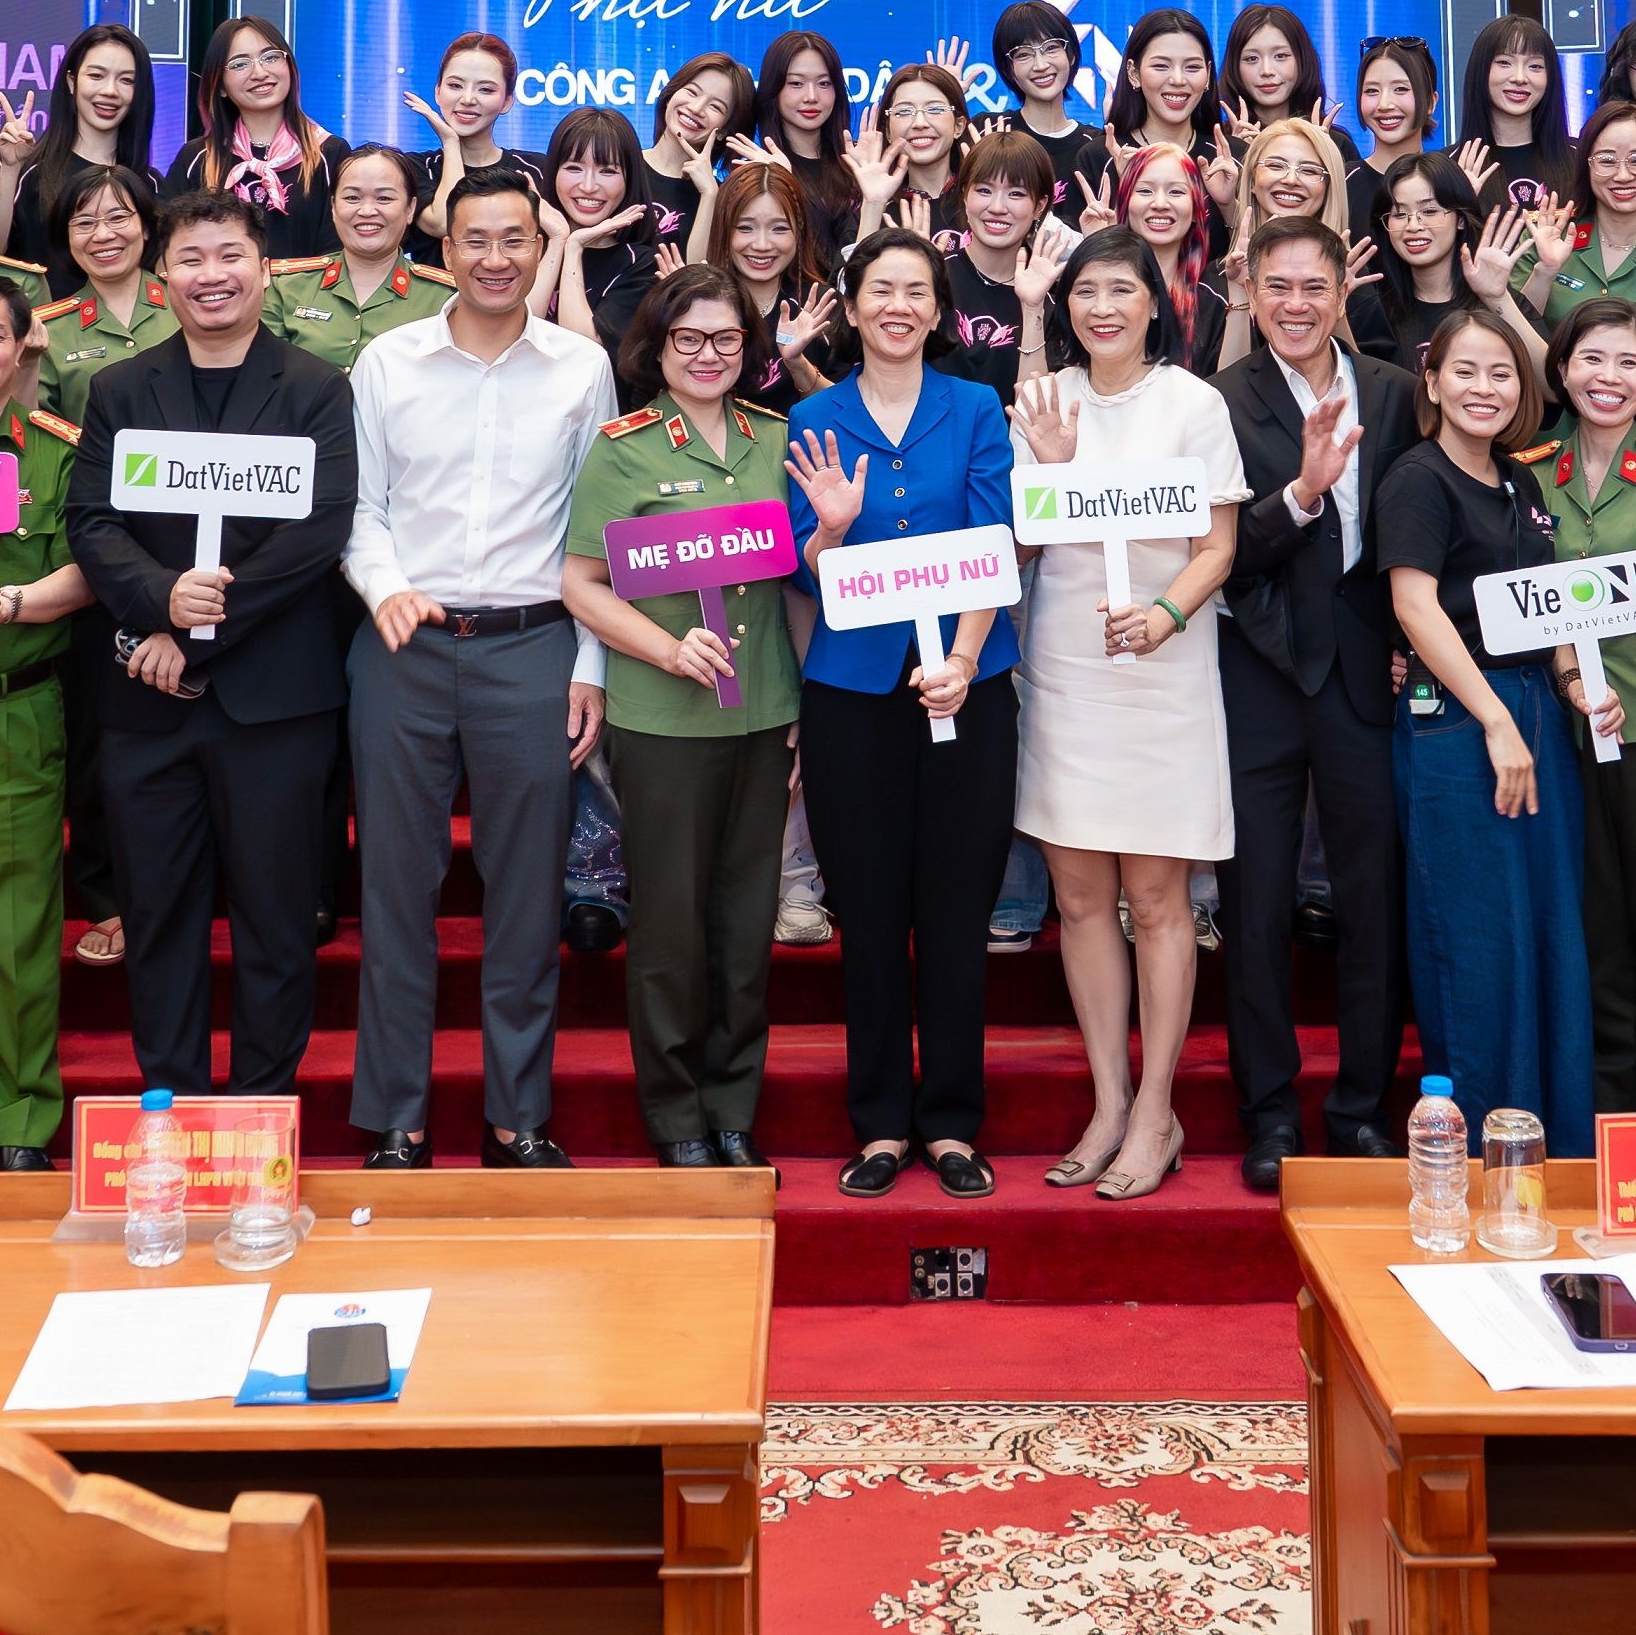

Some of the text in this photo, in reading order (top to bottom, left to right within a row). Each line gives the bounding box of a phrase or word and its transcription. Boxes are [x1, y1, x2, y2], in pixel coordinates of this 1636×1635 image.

[515, 62, 636, 107] CÔNG
[166, 460, 301, 495] DatVietVAC
[1066, 484, 1197, 520] DatVietVAC
[627, 525, 775, 570] MẸ ĐỠ ĐẦU
[838, 554, 1000, 603] HỘI PHỤ NỮ
[1543, 625, 1559, 636] by
